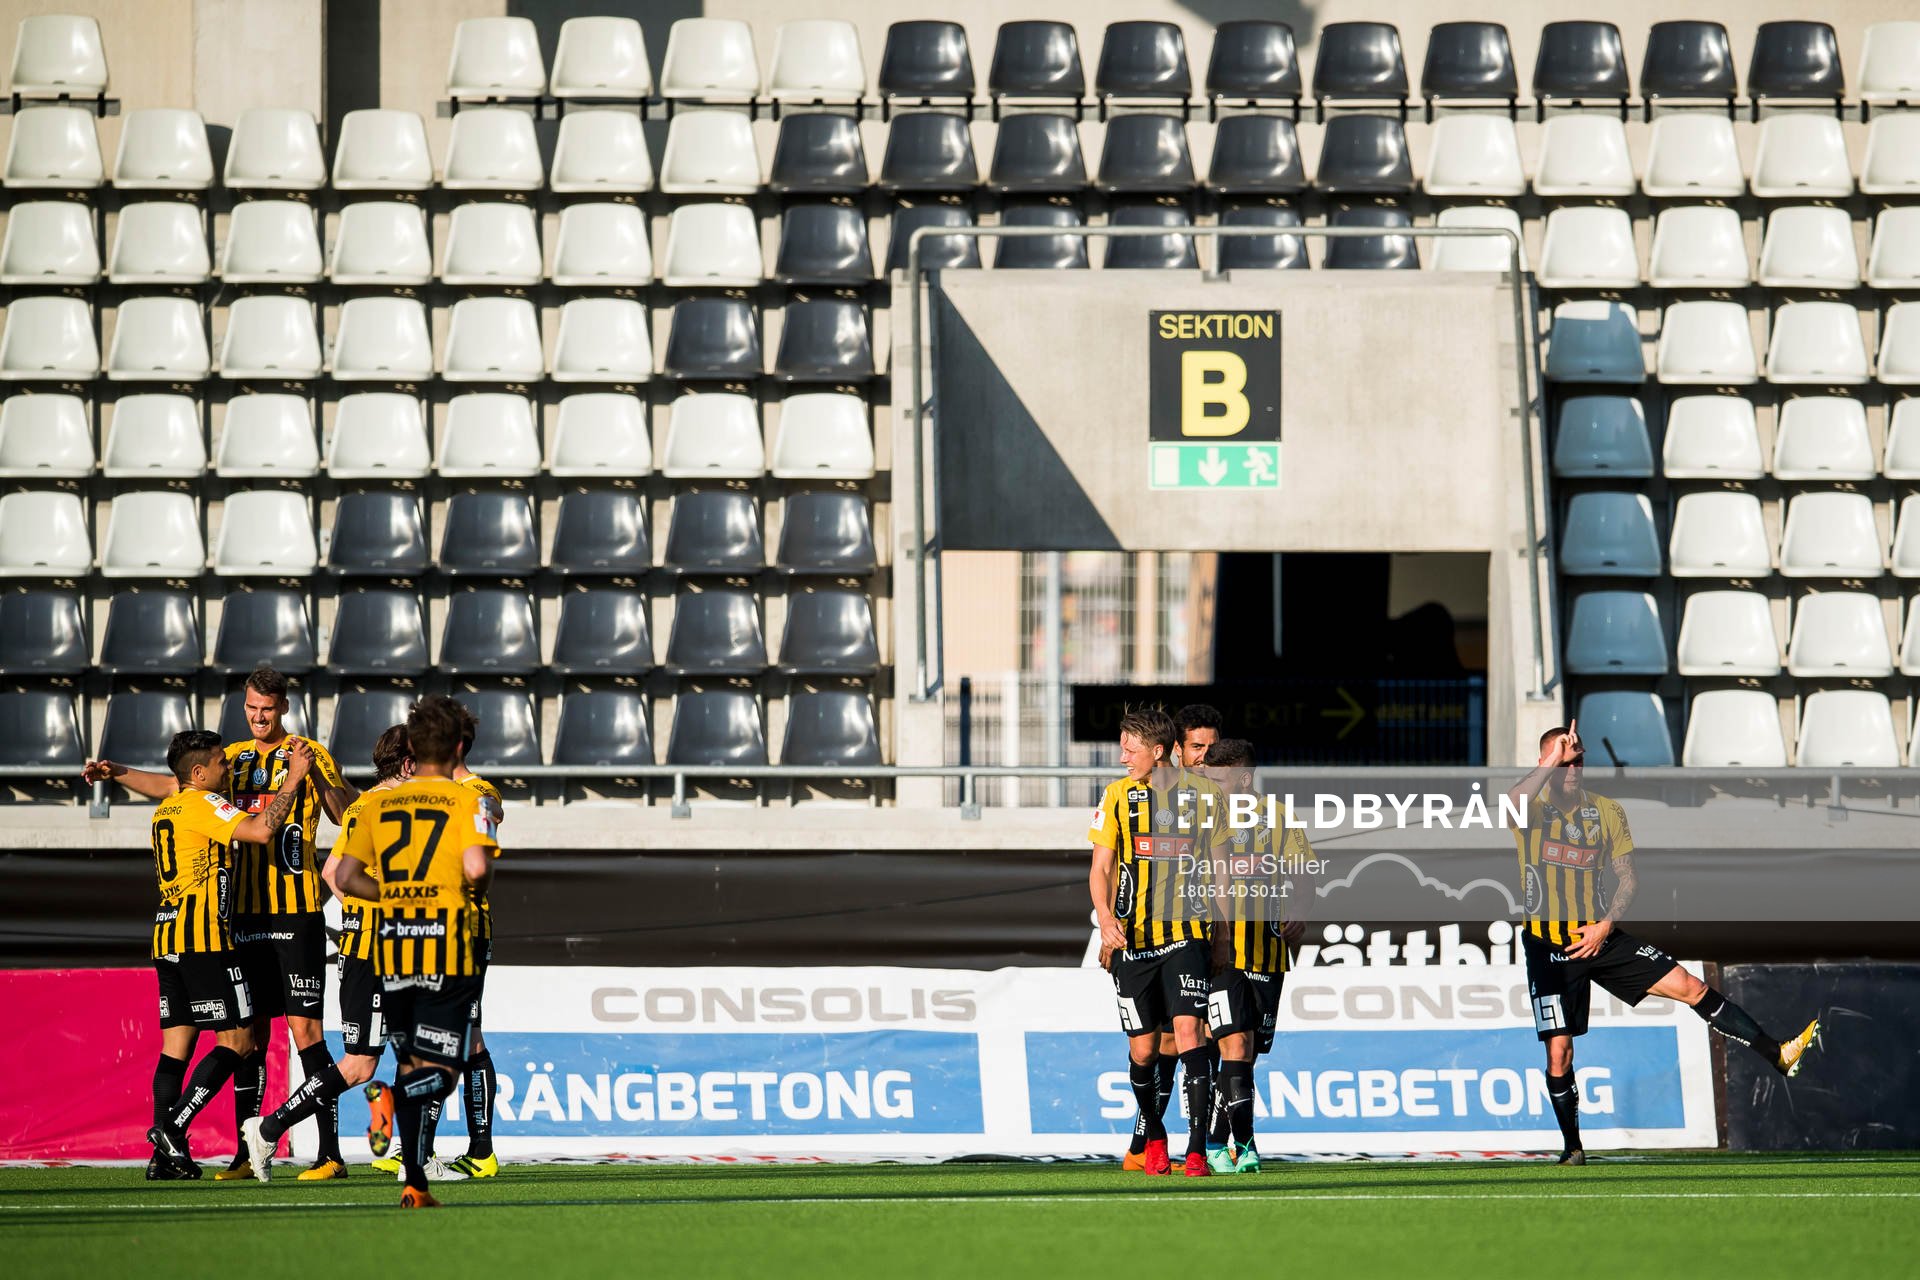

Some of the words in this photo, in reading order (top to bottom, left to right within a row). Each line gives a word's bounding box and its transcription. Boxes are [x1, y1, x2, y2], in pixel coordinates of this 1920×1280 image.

[1159, 314, 1273, 339] SEKTION
[1181, 350, 1250, 436] B
[380, 795, 456, 809] EHRENBORG
[380, 808, 450, 883] 27
[397, 922, 446, 936] bravida
[227, 967, 242, 982] 10
[288, 974, 320, 989] Varis
[372, 993, 381, 1008] 8
[591, 987, 977, 1023] CONSOLIS
